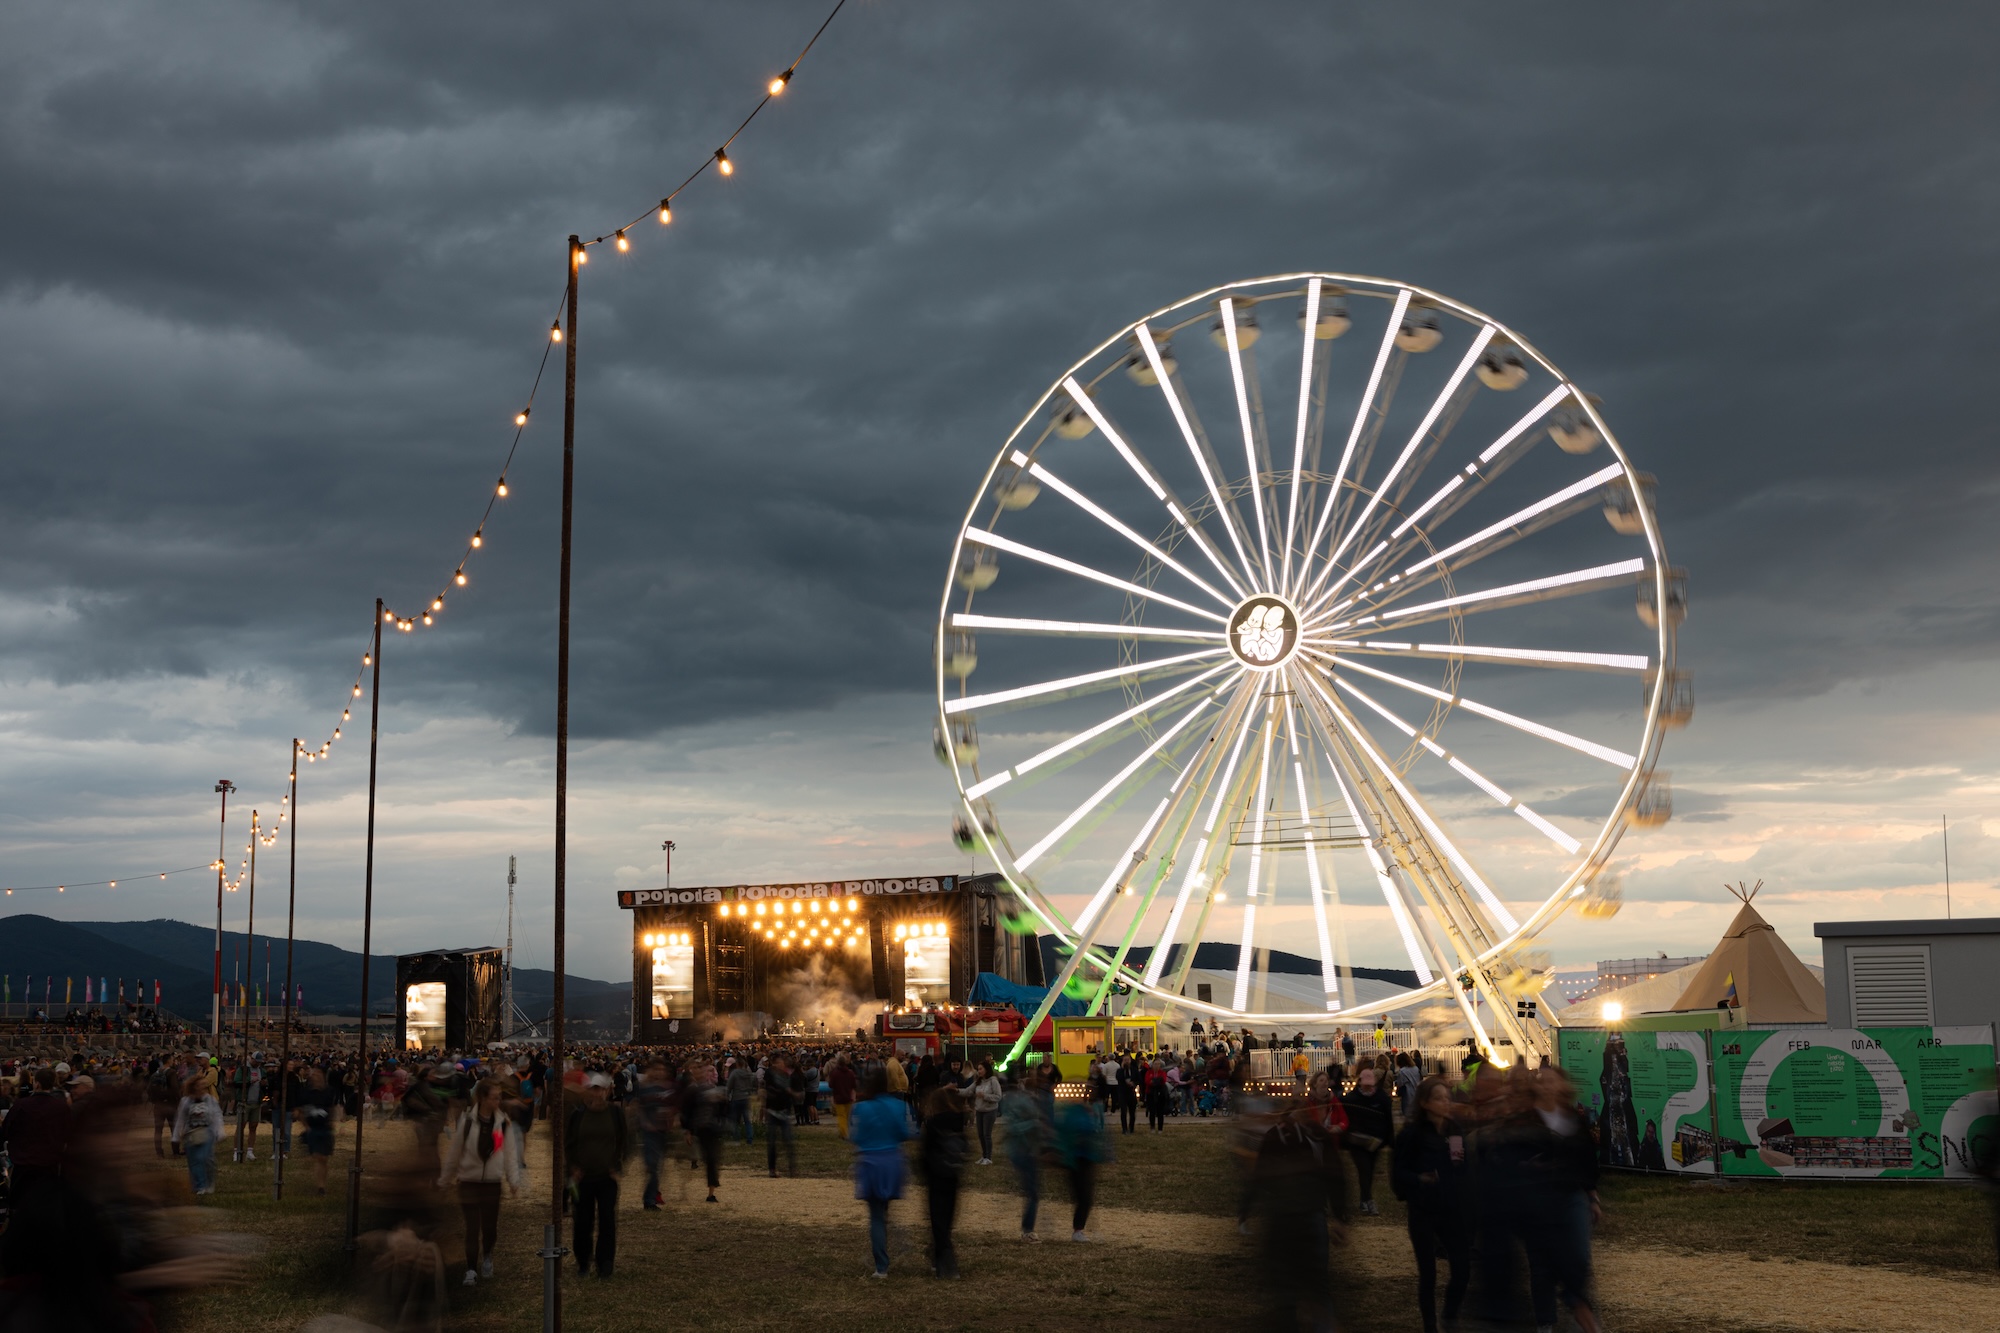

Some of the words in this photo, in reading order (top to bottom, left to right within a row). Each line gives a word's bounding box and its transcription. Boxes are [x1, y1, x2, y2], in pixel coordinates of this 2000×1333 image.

[1567, 1041, 1581, 1050] DEC
[1788, 1041, 1811, 1051] FEB
[1851, 1039, 1882, 1050] MAR
[1917, 1038, 1942, 1049] APR
